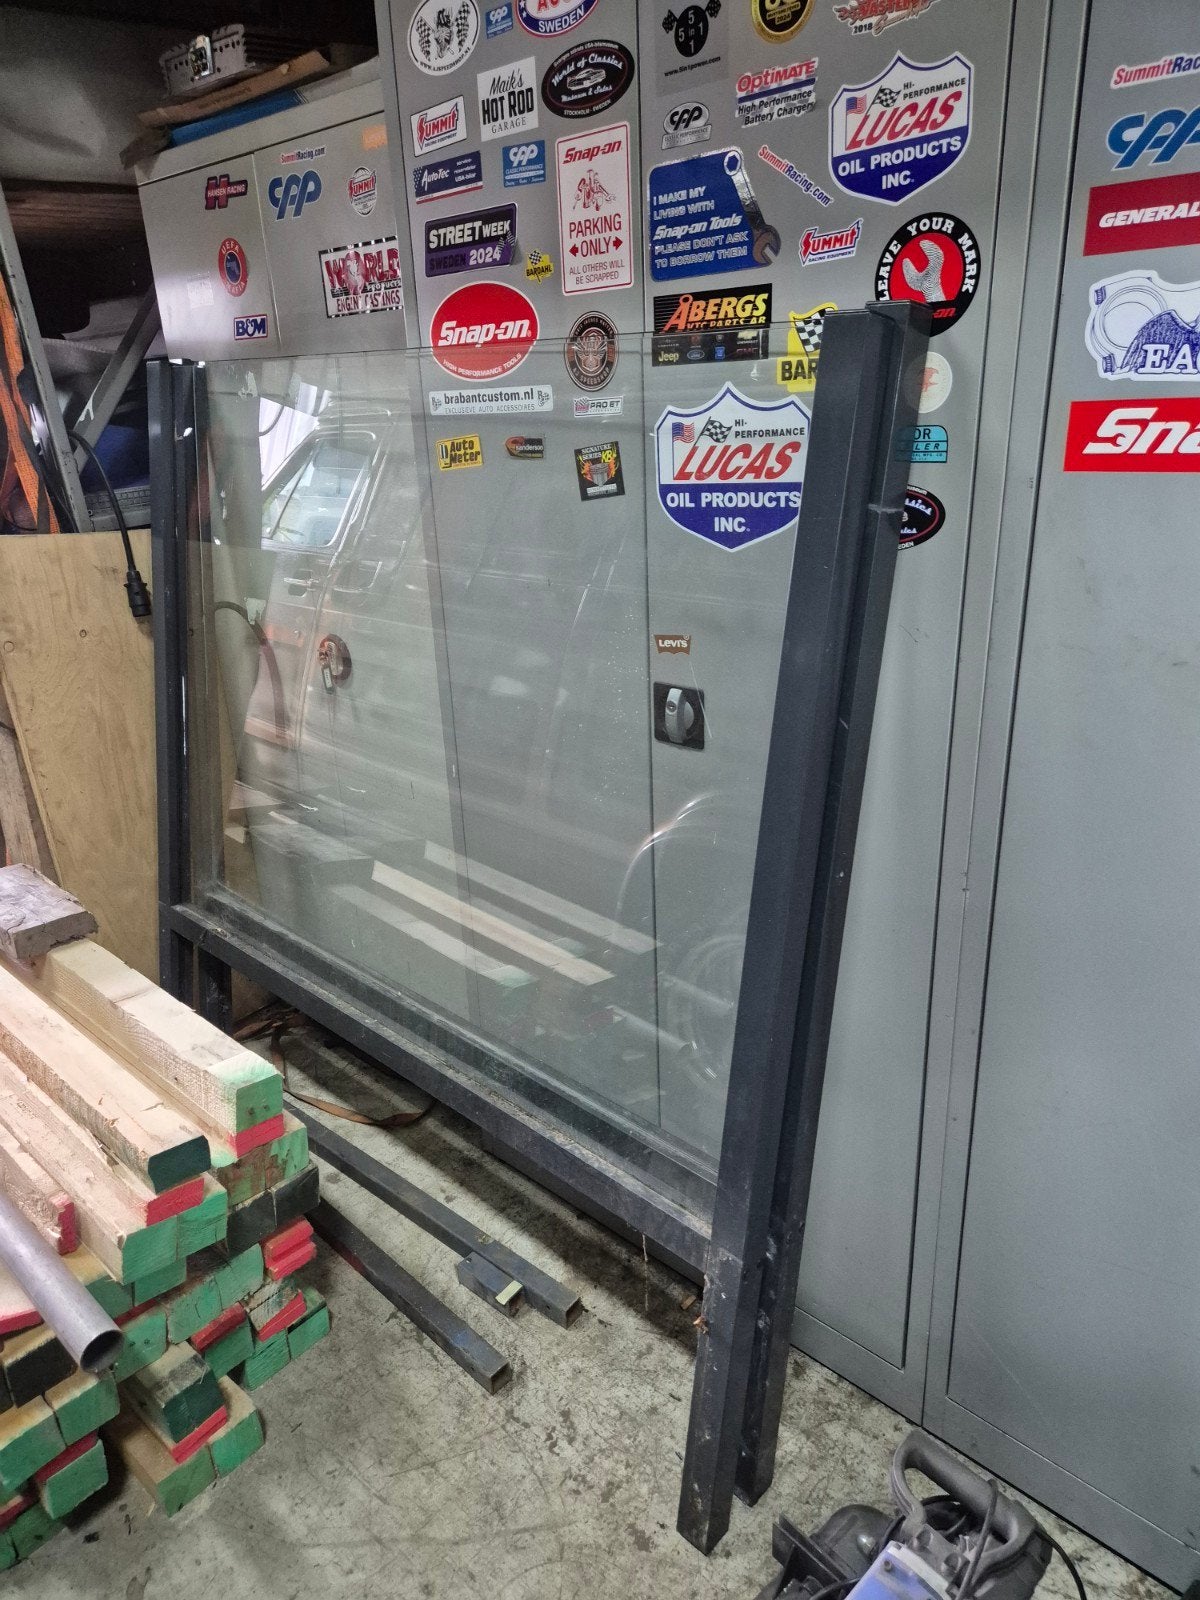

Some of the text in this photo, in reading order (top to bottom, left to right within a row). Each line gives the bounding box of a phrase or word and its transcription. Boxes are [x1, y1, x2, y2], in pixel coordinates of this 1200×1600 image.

[538, 4, 585, 33] SWEDEN
[688, 10, 695, 24] 5
[853, 23, 873, 34] 2018
[678, 28, 685, 42] 5
[489, 68, 523, 95] Maik's
[551, 53, 623, 87] World of Classics
[1114, 56, 1200, 86] SummitRac
[903, 81, 915, 91] HI-
[903, 78, 966, 100] PERFORMANCE
[481, 86, 535, 126] HOT ROD
[738, 89, 813, 115] High Performance
[744, 102, 815, 125] Battery Chargers
[491, 116, 527, 134] GARAGE
[669, 105, 703, 131] CPP
[844, 90, 963, 151] LUCAS
[509, 143, 539, 167] CPP
[562, 139, 622, 165] Snap-on
[837, 135, 962, 177] OIL PRODUCTS
[758, 145, 833, 207] SummitRacing.com
[268, 169, 322, 221] CPP
[658, 190, 688, 205] MAKE
[689, 186, 706, 199] MY
[653, 200, 715, 220] LIVING WITH
[1099, 202, 1200, 228] GENERAL
[569, 213, 622, 239] PARKING
[653, 213, 743, 241] Snap-on Tools
[221, 240, 240, 254] UEFA
[580, 236, 612, 258] ONLY
[654, 230, 749, 255] PLEASE DON'T ASK
[429, 246, 501, 271] SWEDEN 2024
[569, 259, 626, 276] ALL OTHERS WILL
[655, 246, 748, 269] TO BORROW THEM
[877, 217, 978, 301] LEAVE YOUR MARK
[324, 248, 400, 292] WORLD
[526, 265, 553, 277] BARDAHL
[575, 270, 620, 285] BE SCRAPPED
[366, 280, 401, 292] PROUCTS
[336, 295, 362, 313] ENGIN
[662, 293, 769, 333] ÅBERGS
[235, 316, 266, 337] B&M
[437, 319, 530, 348] Snap-on
[443, 353, 522, 377] HIGH PERFORMANCE TOOLS
[658, 351, 679, 363] Jeep
[1137, 344, 1200, 375] EA
[781, 358, 818, 381] BAR
[444, 387, 535, 405] brabantcustom.nl
[590, 400, 620, 409] PRO ET
[445, 403, 536, 415] EXCLUSIEVE AUTO ACCESSOIRES
[734, 419, 747, 427] HI-
[734, 427, 806, 439] PERFORMANCE
[914, 428, 932, 440] OR
[1082, 407, 1200, 455] Sna
[450, 439, 474, 453] Auto
[450, 450, 480, 464] Meter
[582, 450, 613, 463] SERIES KB
[673, 441, 802, 481] LUCAS
[666, 491, 801, 508] OIL PRODUCTS
